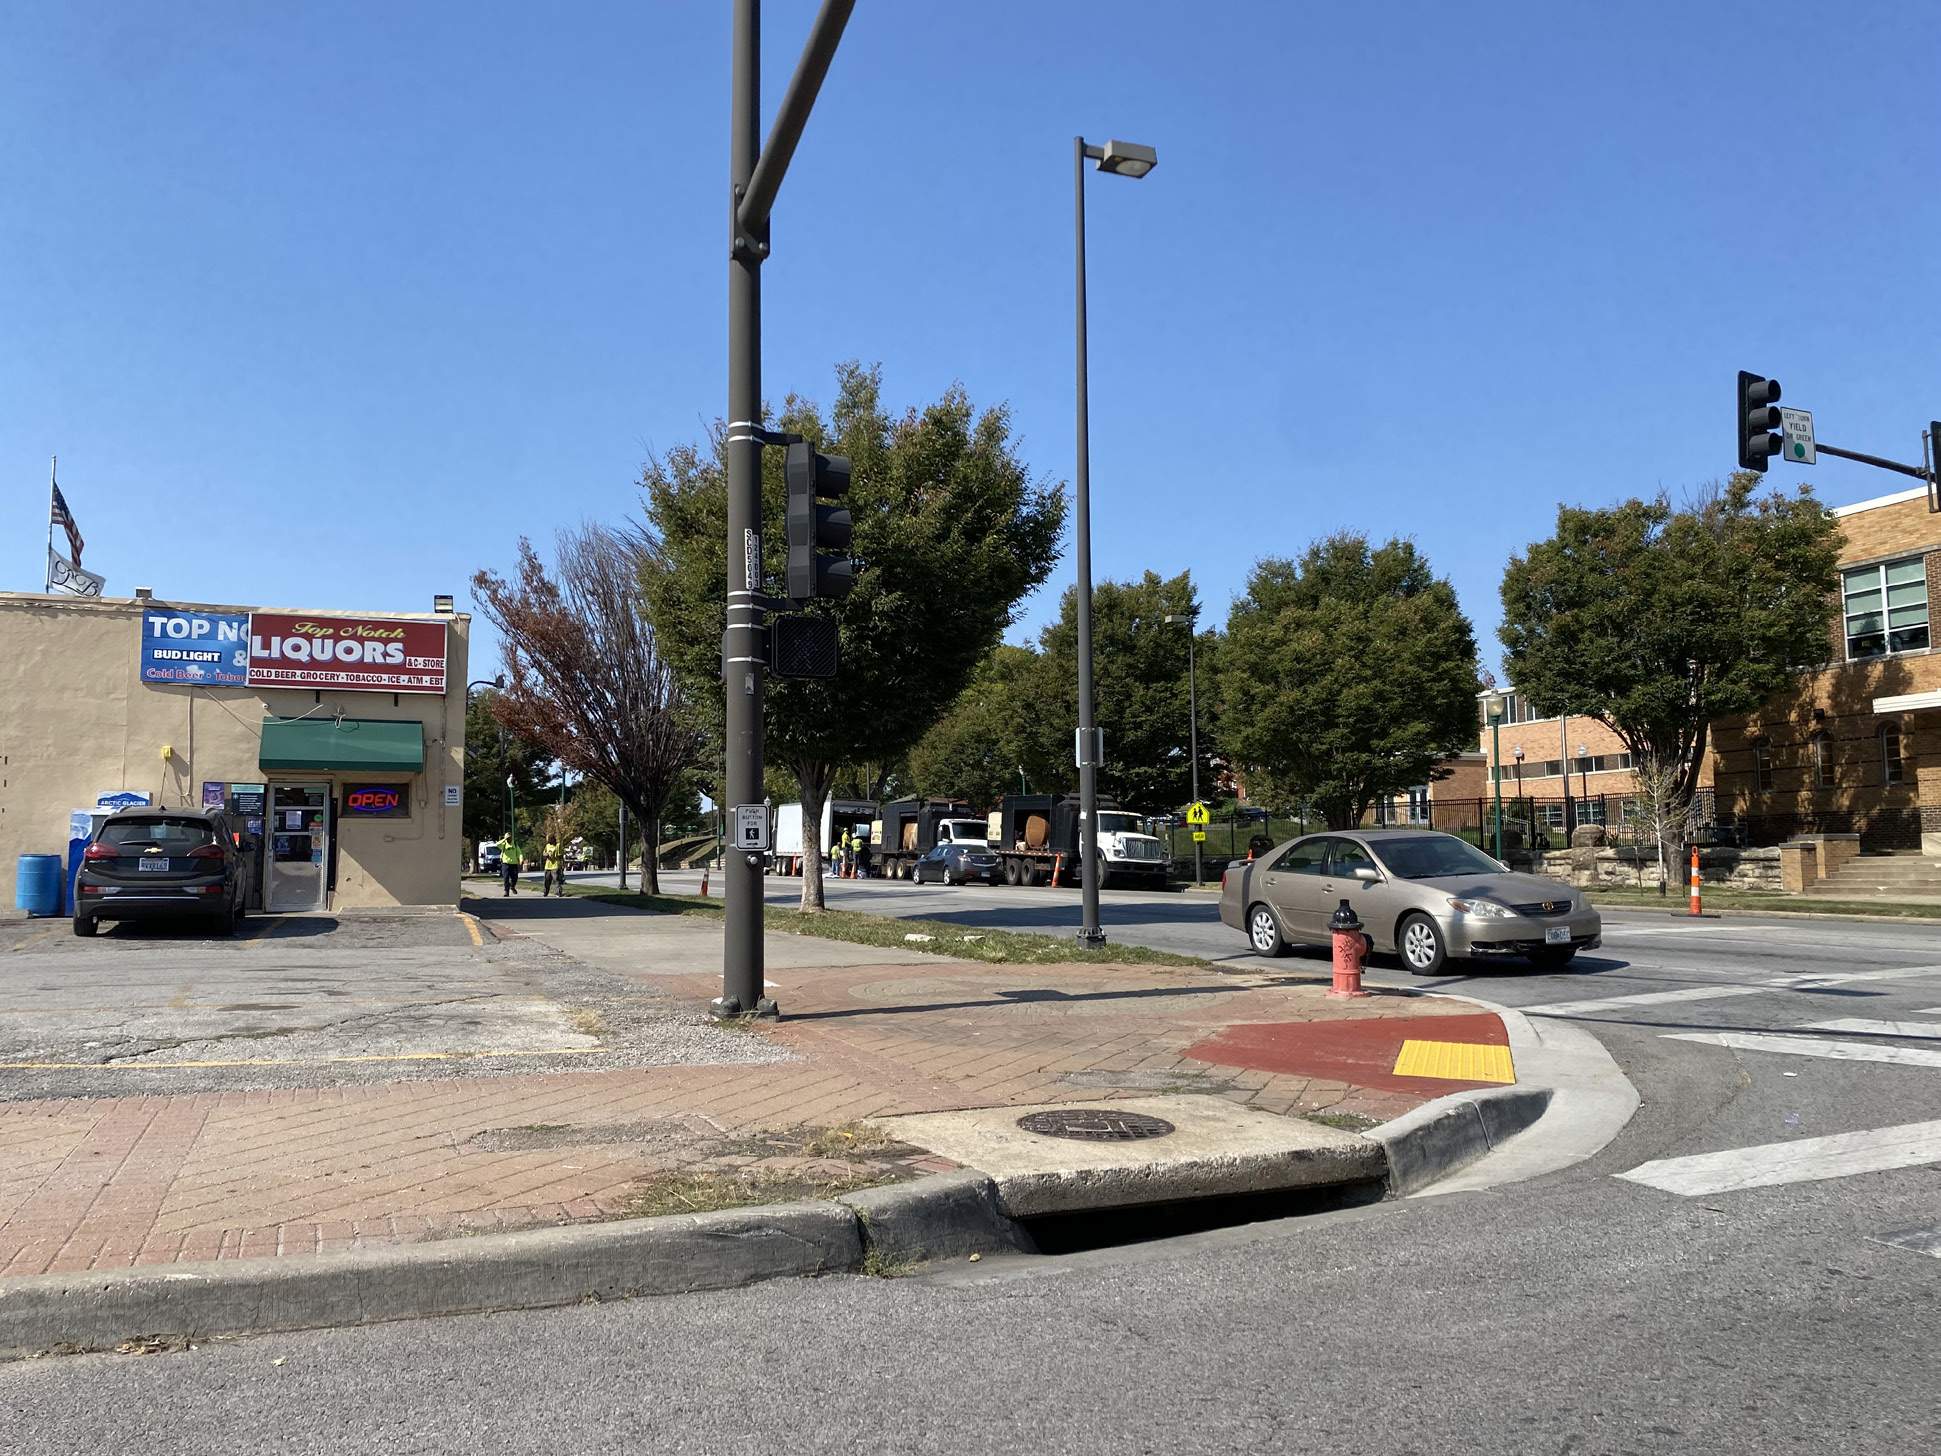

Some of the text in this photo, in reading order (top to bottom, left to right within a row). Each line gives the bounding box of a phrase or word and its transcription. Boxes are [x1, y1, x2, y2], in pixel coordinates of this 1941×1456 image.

[1789, 422, 1807, 432] YIELD
[149, 616, 210, 639] TOP
[291, 622, 406, 638] Top Notch
[153, 649, 221, 662] BUD LIGHT
[251, 635, 405, 665] LIQUORS
[147, 667, 174, 678] Cold
[175, 668, 203, 680] Beer
[250, 669, 273, 678] COLD
[387, 675, 401, 684] ICE
[406, 676, 424, 685] ATM
[429, 677, 444, 686] EBT
[348, 793, 400, 806] OPEN
